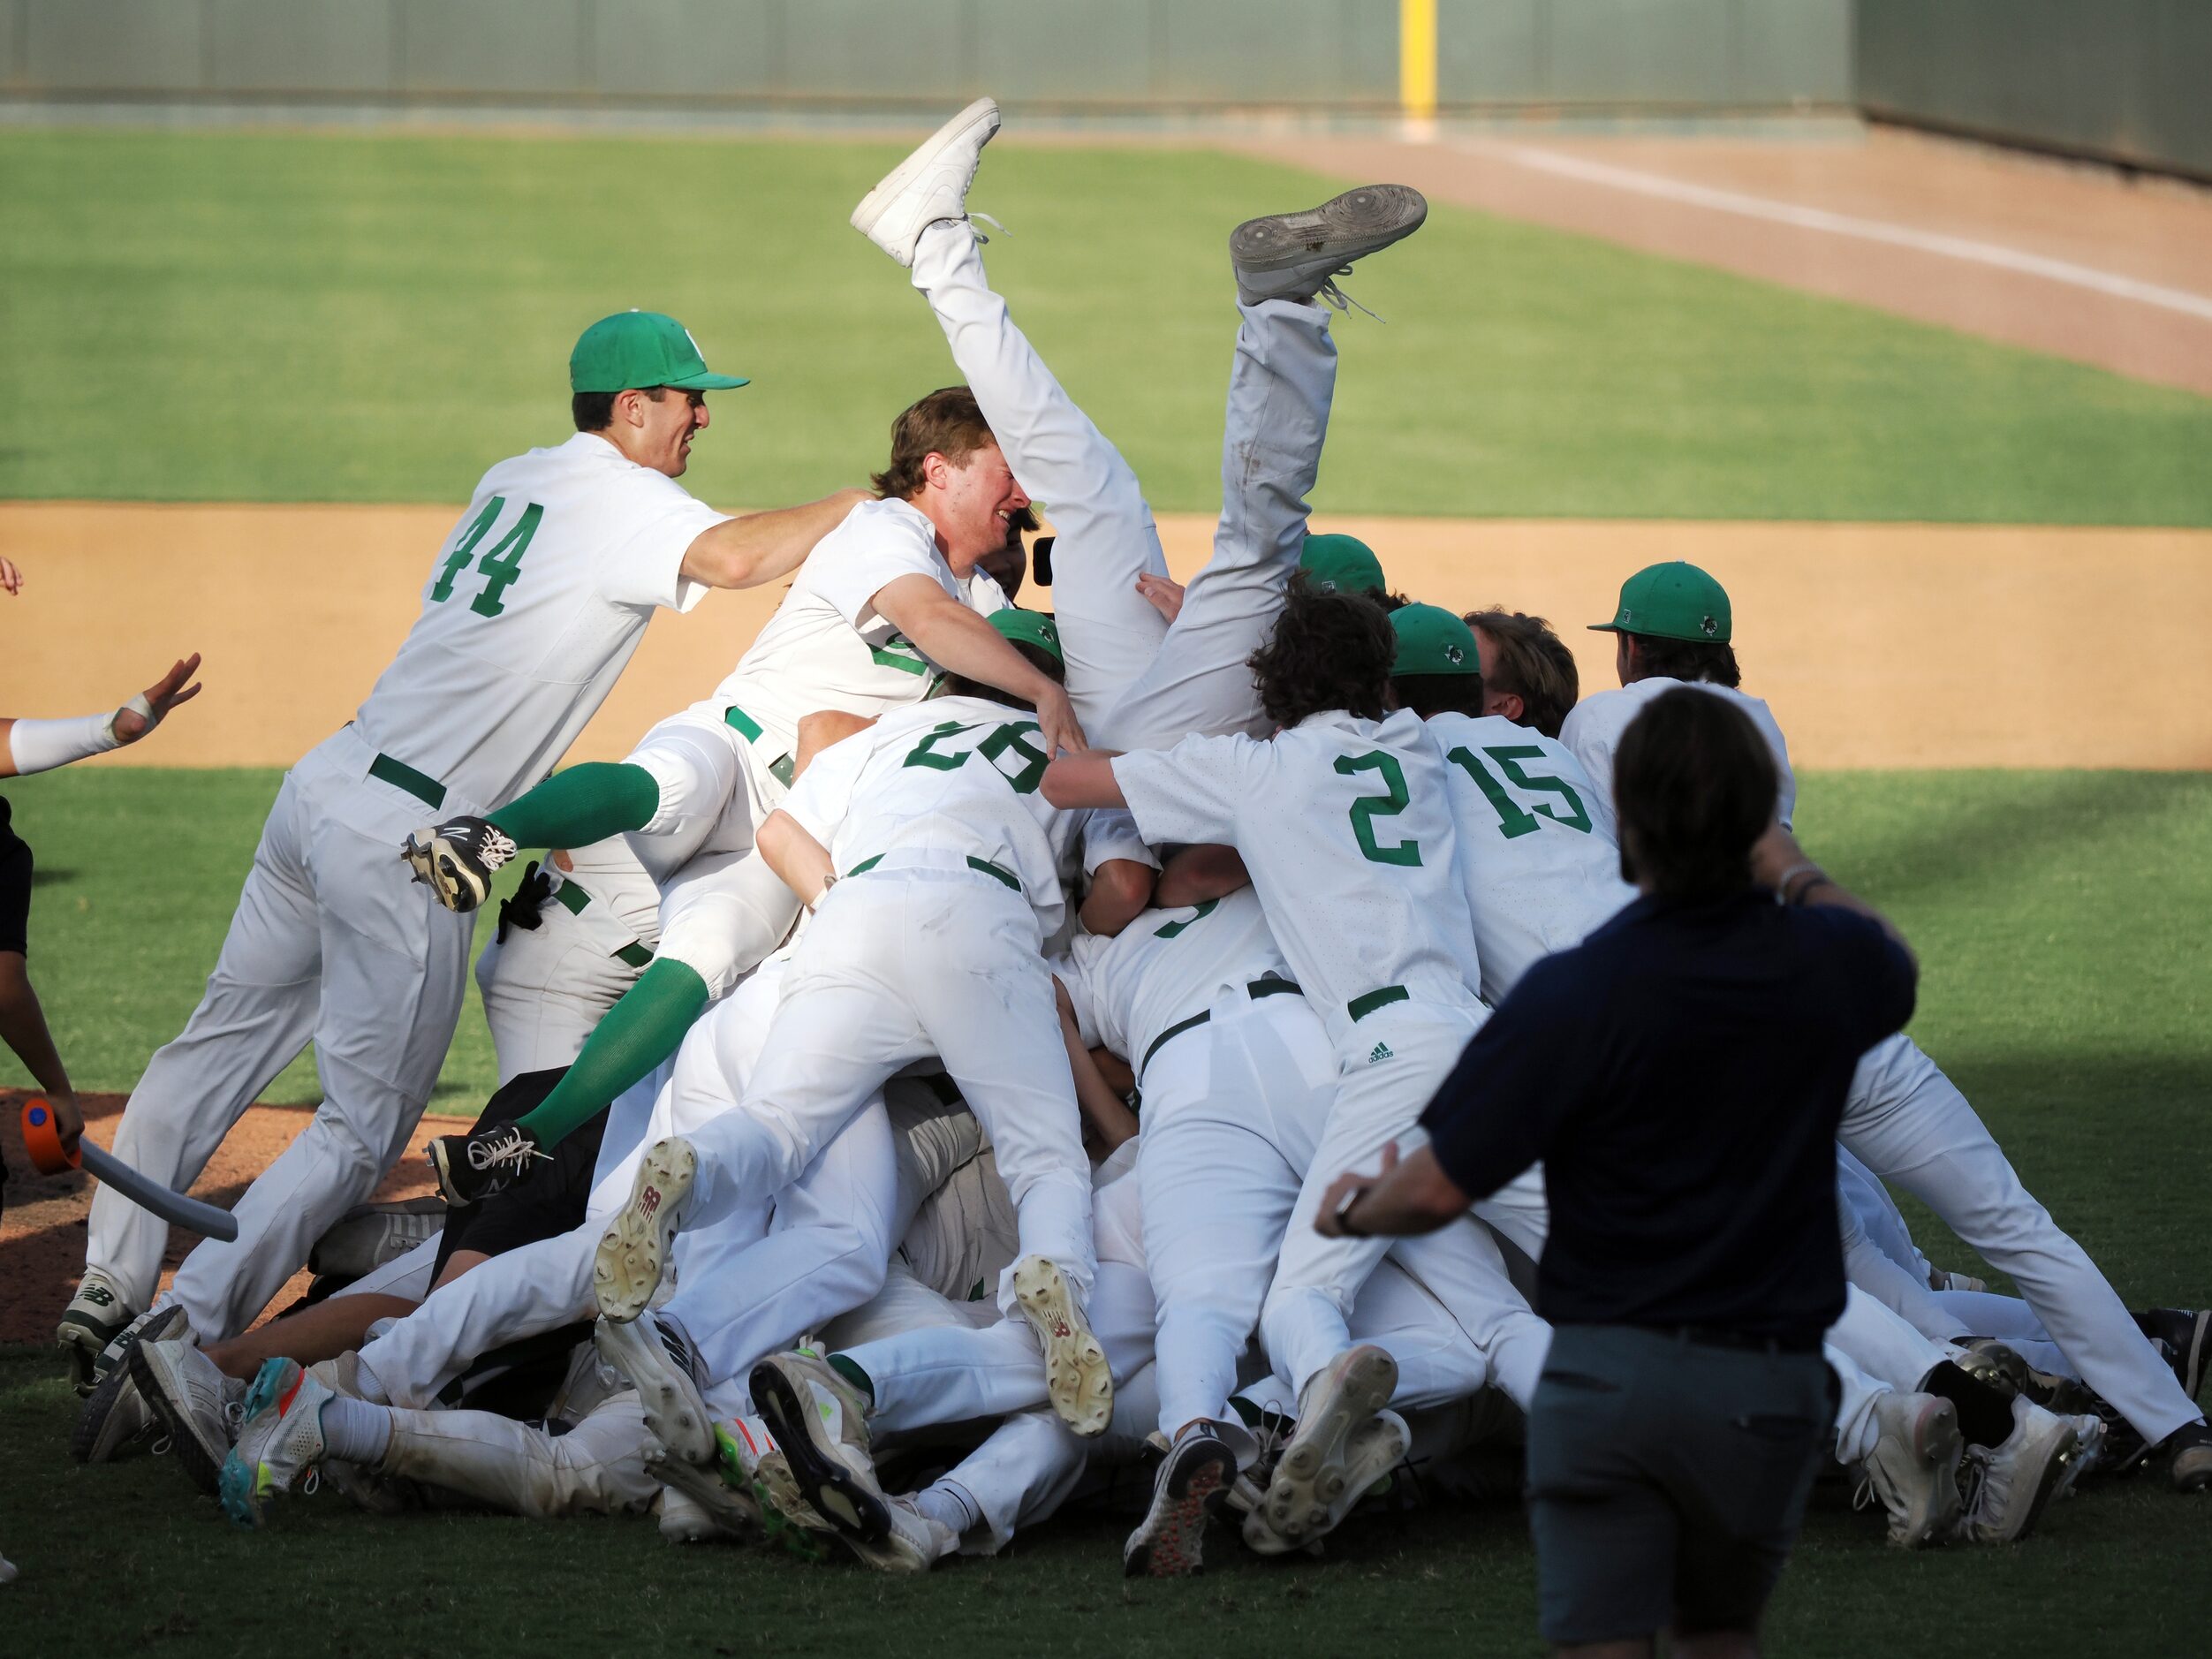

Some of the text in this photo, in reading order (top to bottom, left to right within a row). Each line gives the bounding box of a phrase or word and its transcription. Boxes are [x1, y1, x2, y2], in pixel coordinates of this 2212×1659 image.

[430, 496, 544, 618] 44
[1333, 750, 1424, 867] 2
[1446, 745, 1593, 839] 15
[1368, 1050, 1394, 1064] adidas
